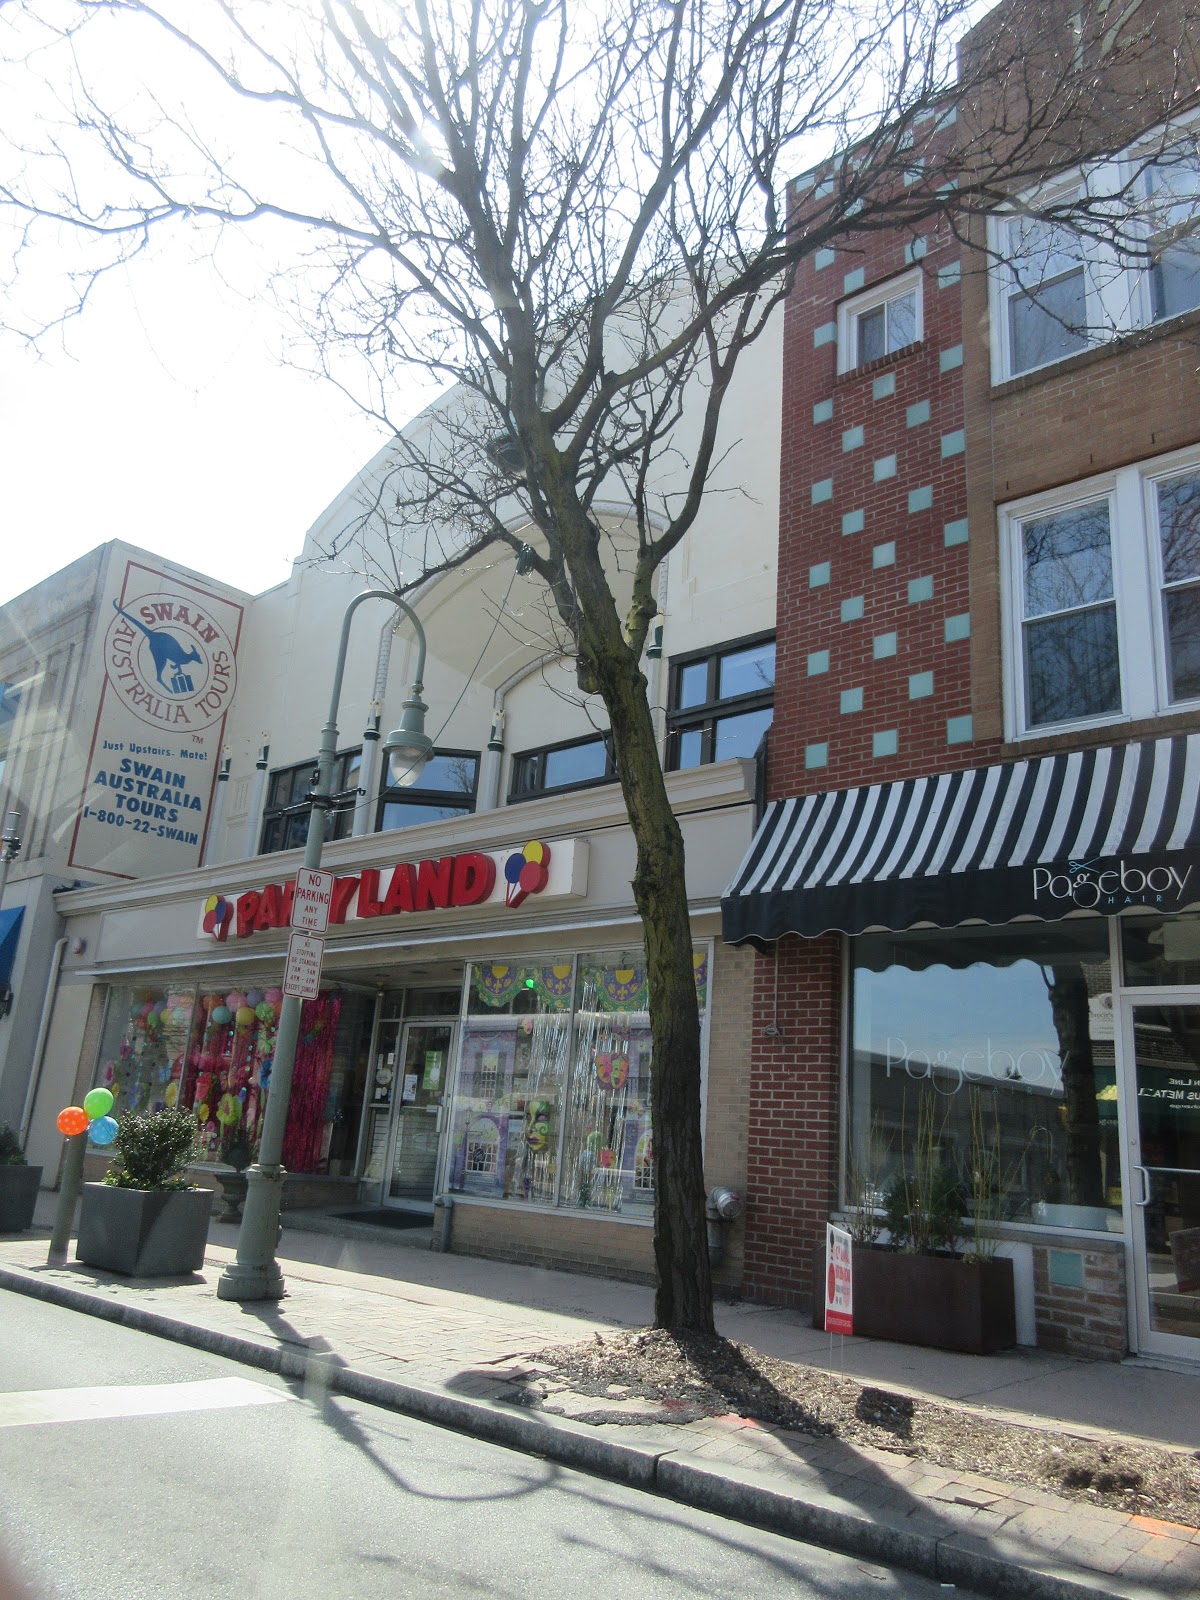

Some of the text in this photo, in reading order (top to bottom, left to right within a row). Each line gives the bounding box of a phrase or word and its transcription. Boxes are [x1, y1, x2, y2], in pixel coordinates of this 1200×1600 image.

[140, 602, 220, 644] SWAIN
[111, 618, 231, 724] AUSTRALIA TOURS
[103, 740, 124, 751] Just
[180, 749, 208, 760] Mate!
[192, 734, 204, 745] TM
[120, 758, 186, 789] SWAIN
[94, 770, 202, 812] AUSTRALIA
[115, 793, 179, 823] TOURS
[83, 805, 199, 845] 1-800-22-SWAIN
[237, 851, 497, 938] PARYLAND
[296, 887, 330, 905] PARKING
[308, 874, 322, 888] NO
[1032, 859, 1193, 908] Pageboy
[304, 905, 318, 914] ANY
[1107, 894, 1162, 904] HAIR
[301, 916, 318, 927] TIME
[886, 1036, 1070, 1096] Pageboy
